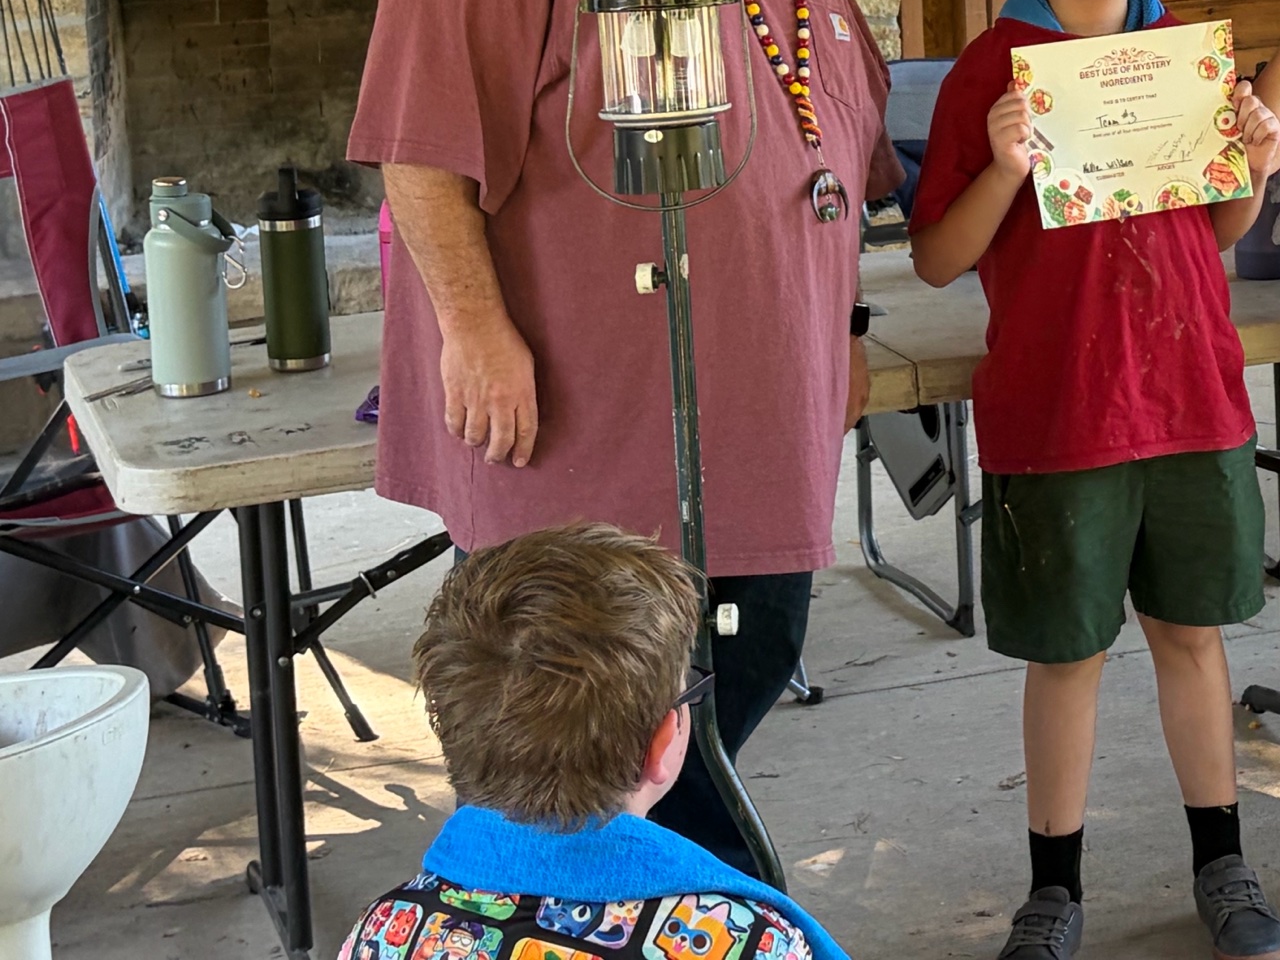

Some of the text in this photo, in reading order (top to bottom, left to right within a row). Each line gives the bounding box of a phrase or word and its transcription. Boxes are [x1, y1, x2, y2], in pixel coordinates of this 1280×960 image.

[1079, 59, 1171, 80] BEST USE OF MYSTERY
[1099, 73, 1154, 88] INGREDIENTS
[1096, 109, 1137, 128] Team #3
[1105, 158, 1134, 170] Wilson
